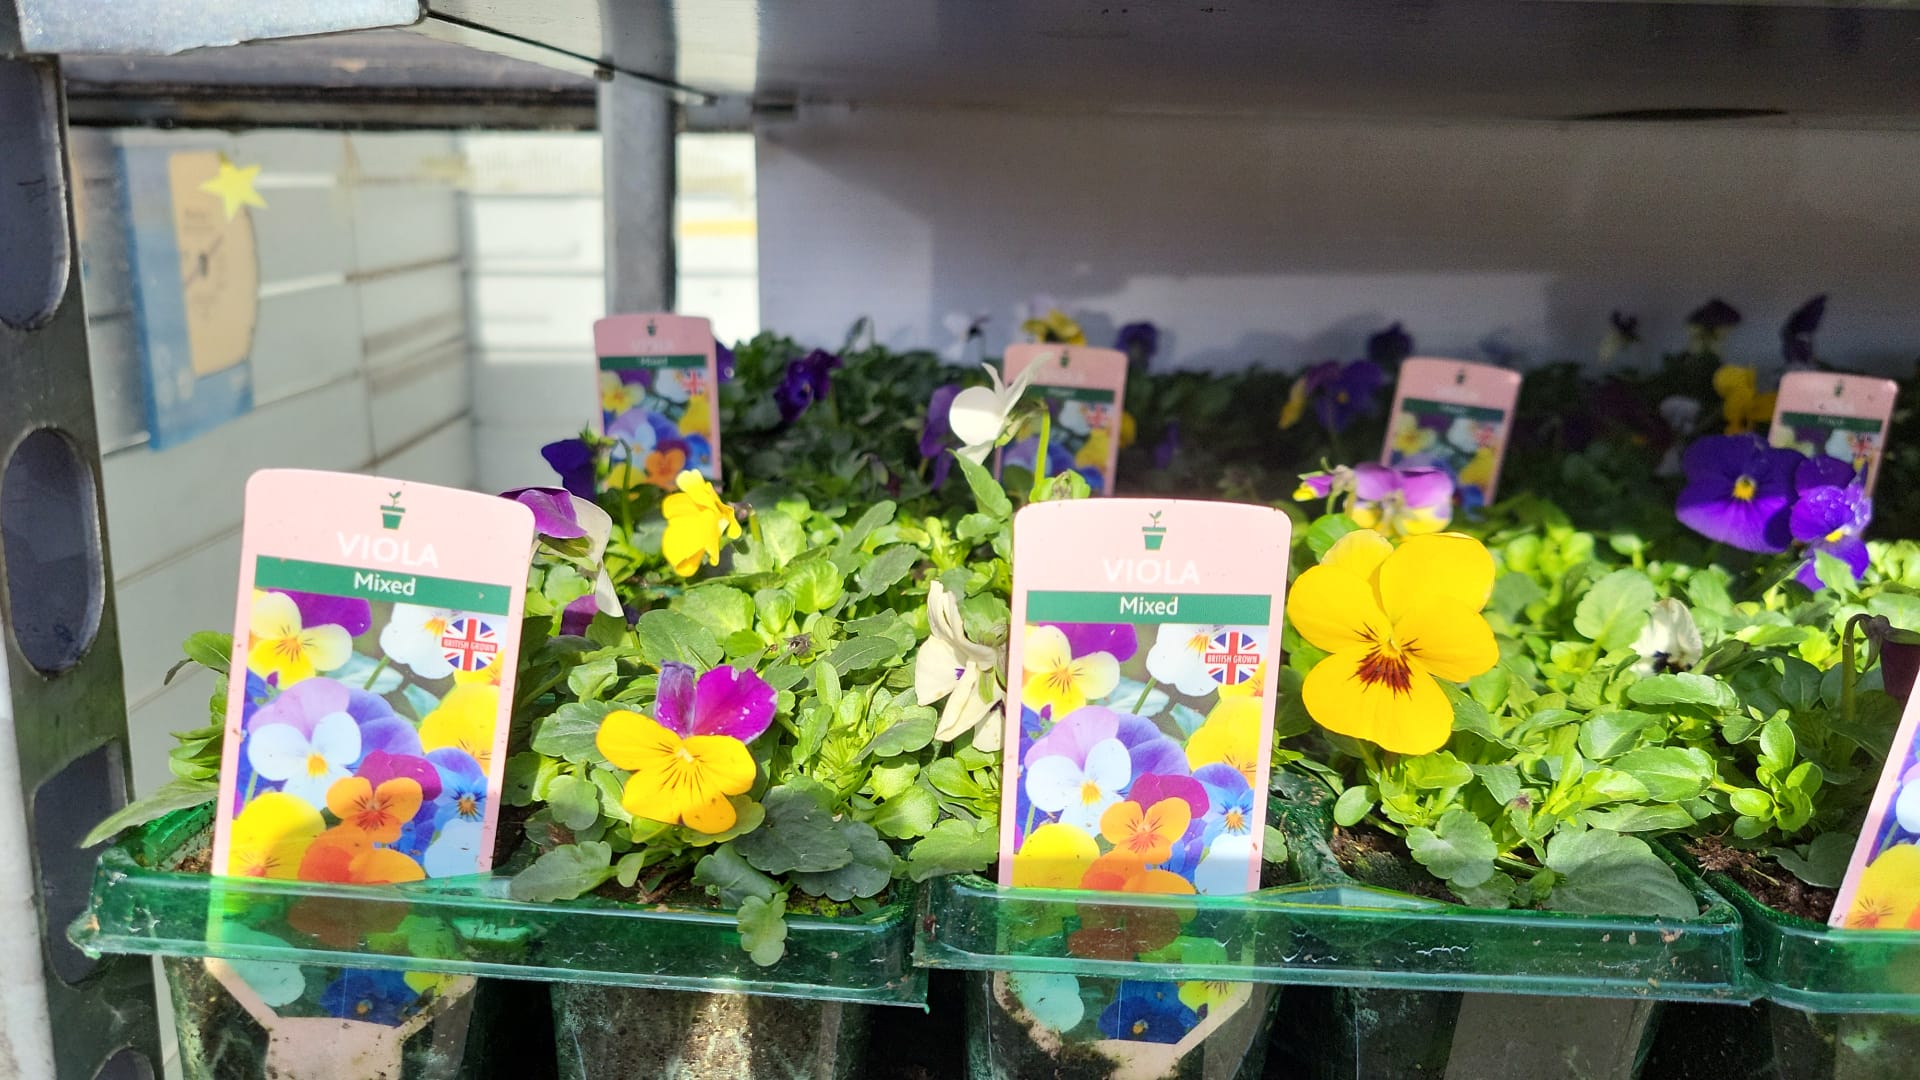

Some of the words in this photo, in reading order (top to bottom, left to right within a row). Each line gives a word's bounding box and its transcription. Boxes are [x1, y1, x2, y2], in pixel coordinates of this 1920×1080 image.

[336, 531, 439, 568] VIOLA
[353, 571, 416, 597] Mixed
[1102, 558, 1200, 585] VIOLA
[1119, 595, 1179, 617] Mixed
[1207, 654, 1231, 664] BRITISH
[1233, 654, 1257, 664] GROWN
